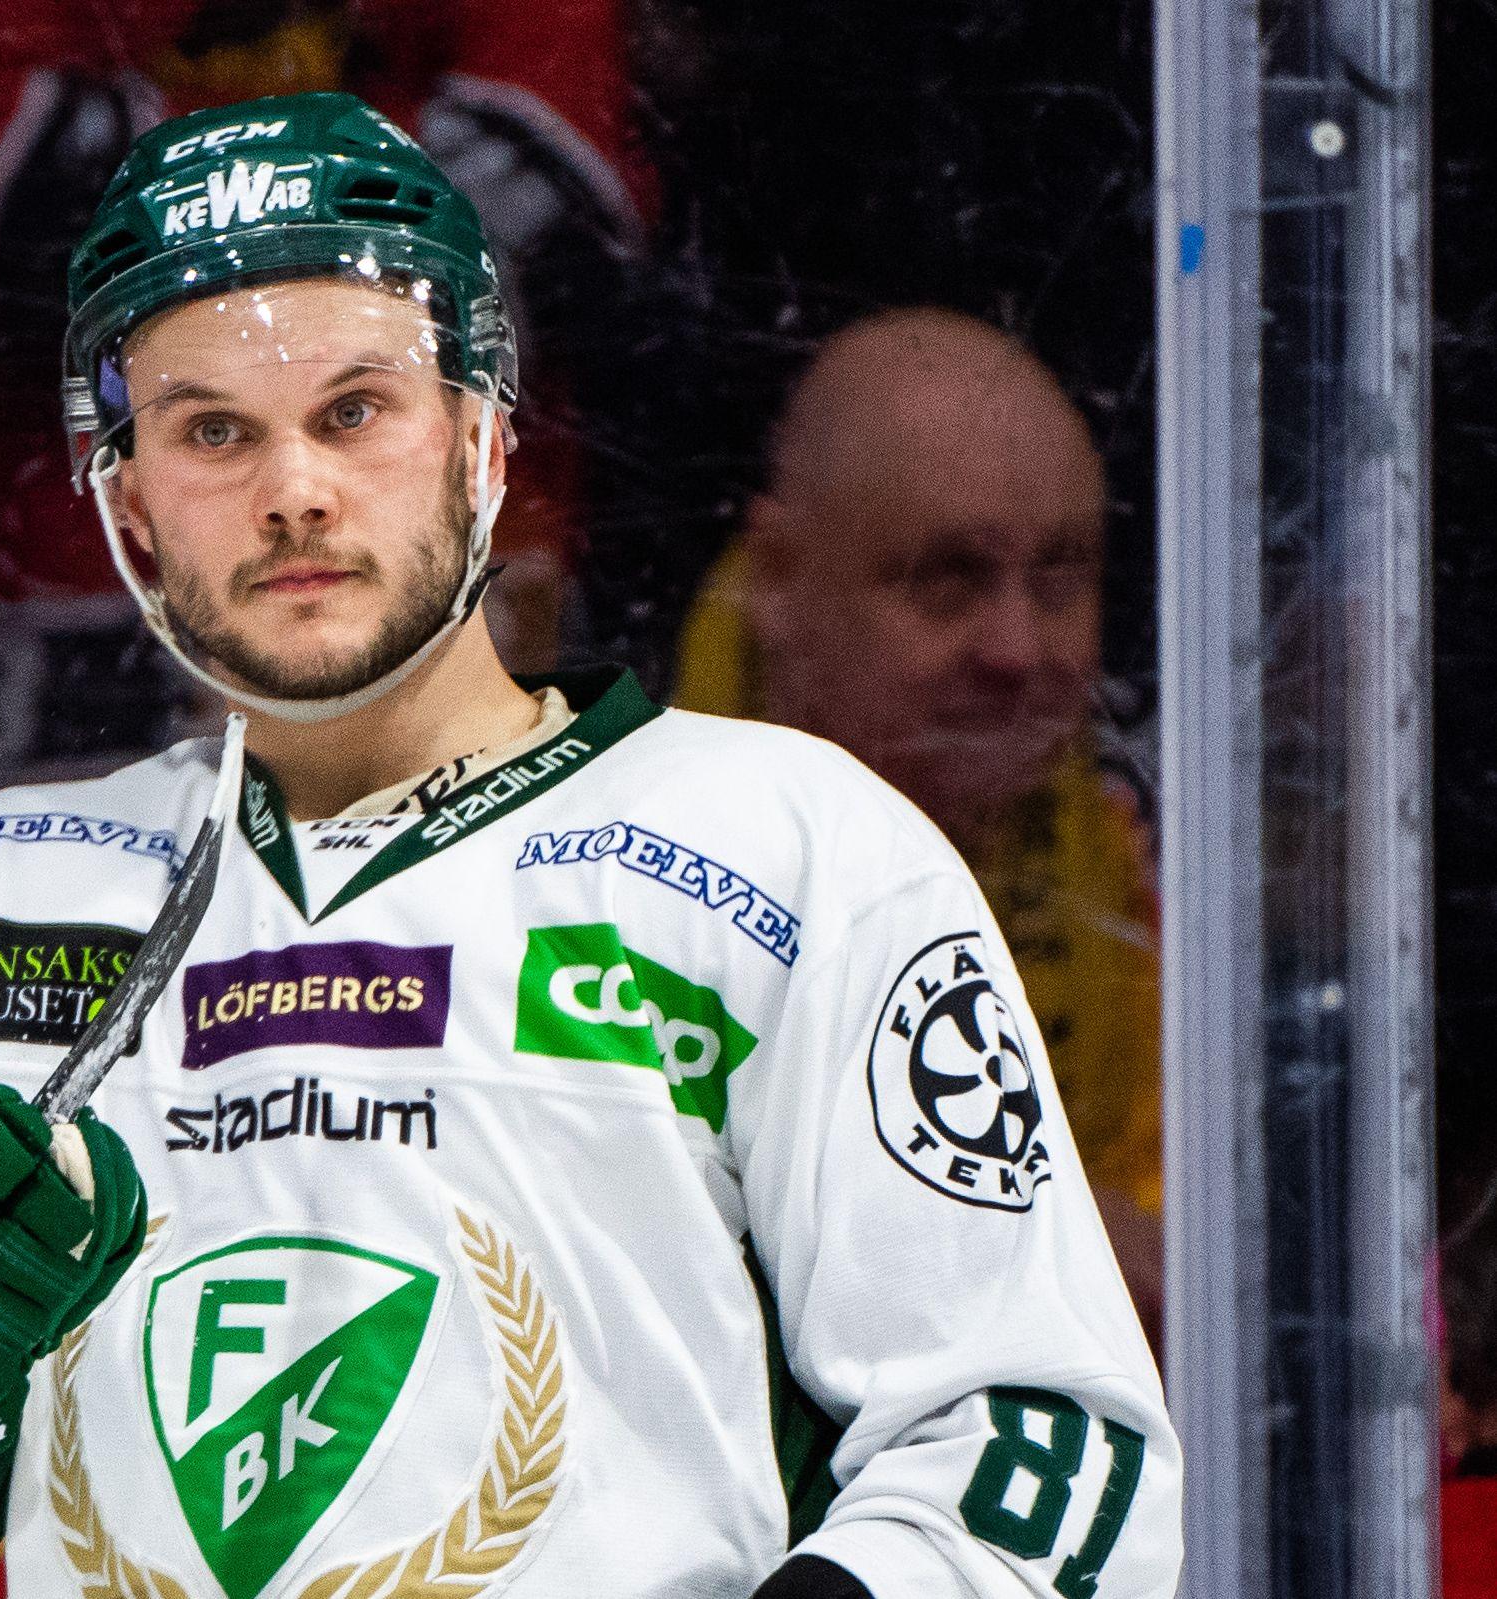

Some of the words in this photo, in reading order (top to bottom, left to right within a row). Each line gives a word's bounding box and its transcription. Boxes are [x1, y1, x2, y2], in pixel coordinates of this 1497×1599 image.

[164, 119, 288, 164] CCM
[421, 738, 592, 847] stadium
[311, 834, 374, 851] SHL
[197, 974, 425, 1031] LÖFBERGS
[890, 945, 984, 1041] FLÄ
[165, 1076, 437, 1154] stadium
[959, 1384, 1146, 1599] 81
